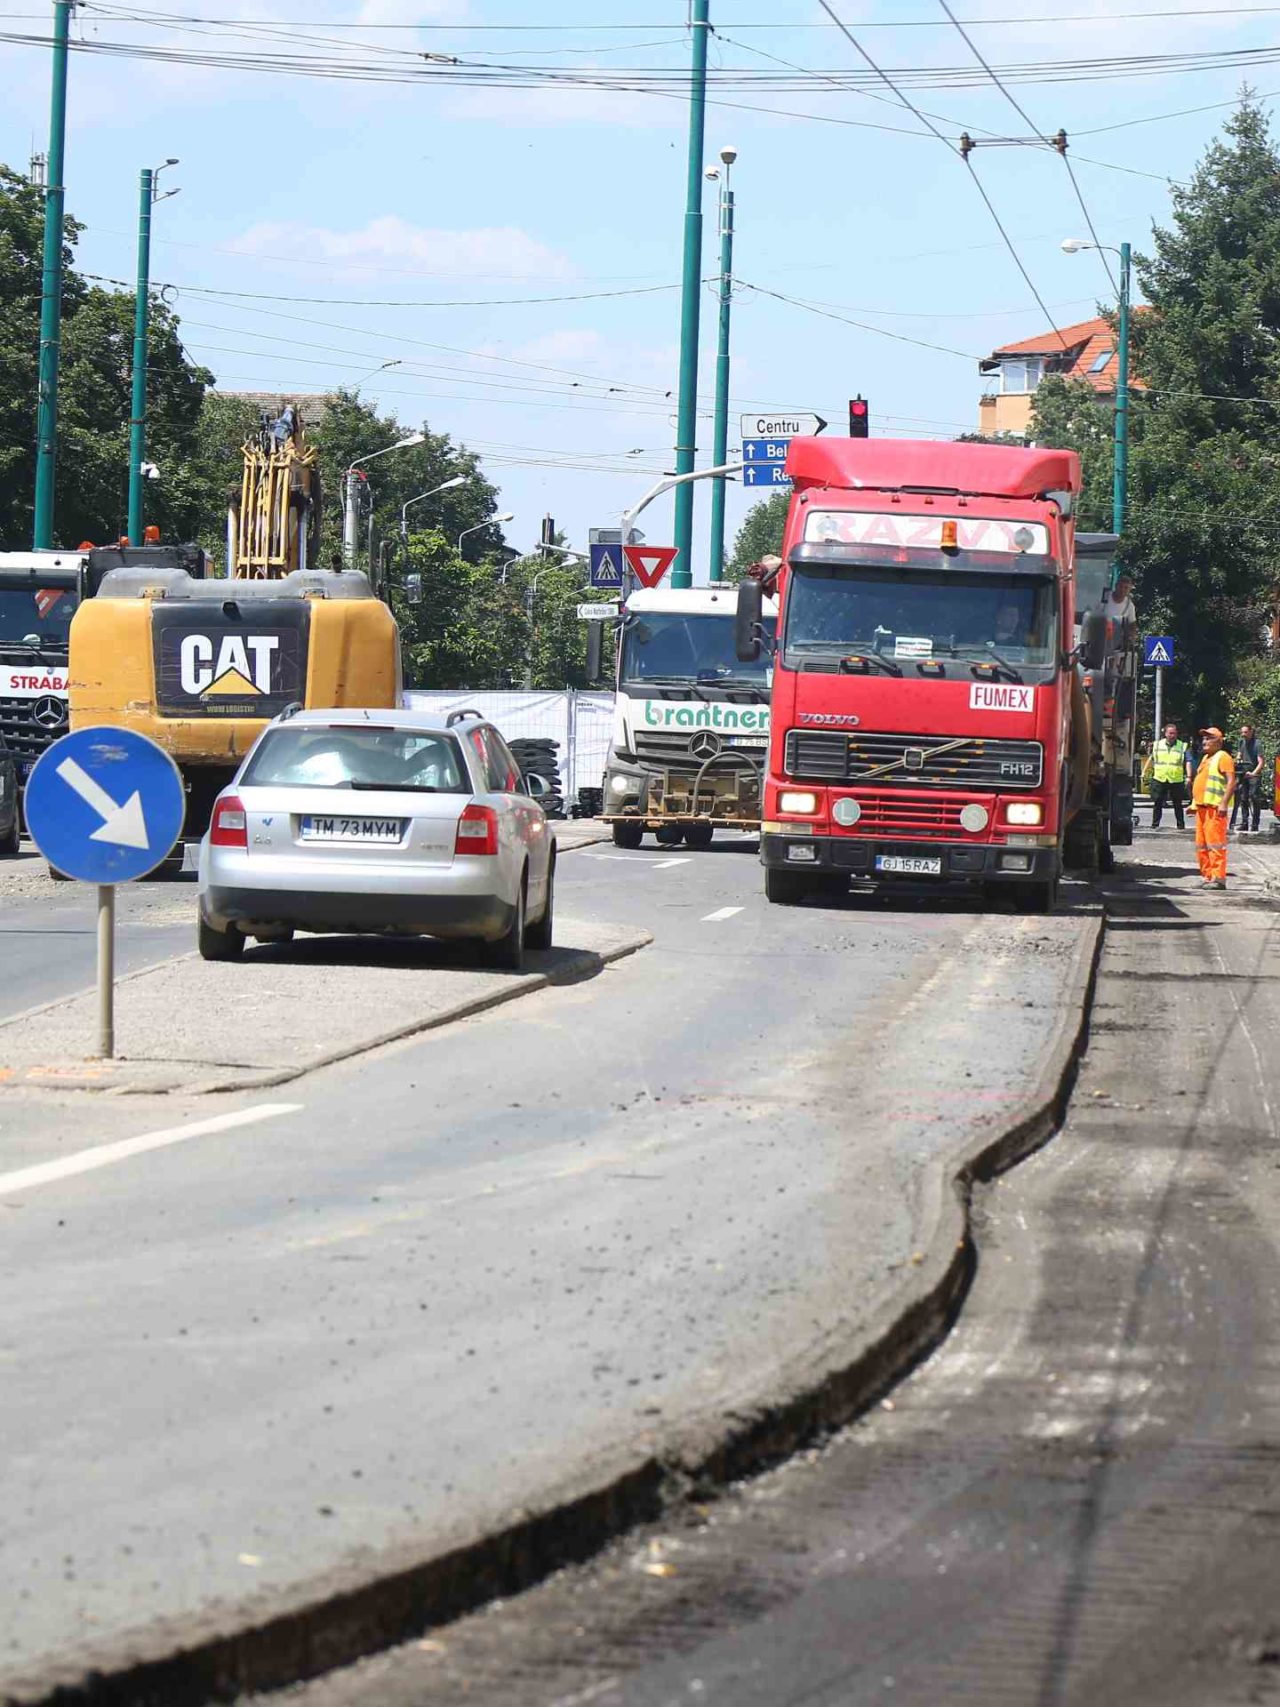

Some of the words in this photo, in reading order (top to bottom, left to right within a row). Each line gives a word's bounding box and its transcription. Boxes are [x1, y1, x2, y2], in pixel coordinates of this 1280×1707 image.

[757, 419, 800, 434] Centru
[772, 468, 792, 481] Re
[181, 634, 279, 695] CAT
[974, 687, 1029, 709] FUMEX
[644, 700, 769, 729] brantner
[798, 712, 860, 726] VOLVO
[1000, 763, 1034, 776] FH12
[314, 818, 334, 835] TM
[883, 858, 898, 870] GJ
